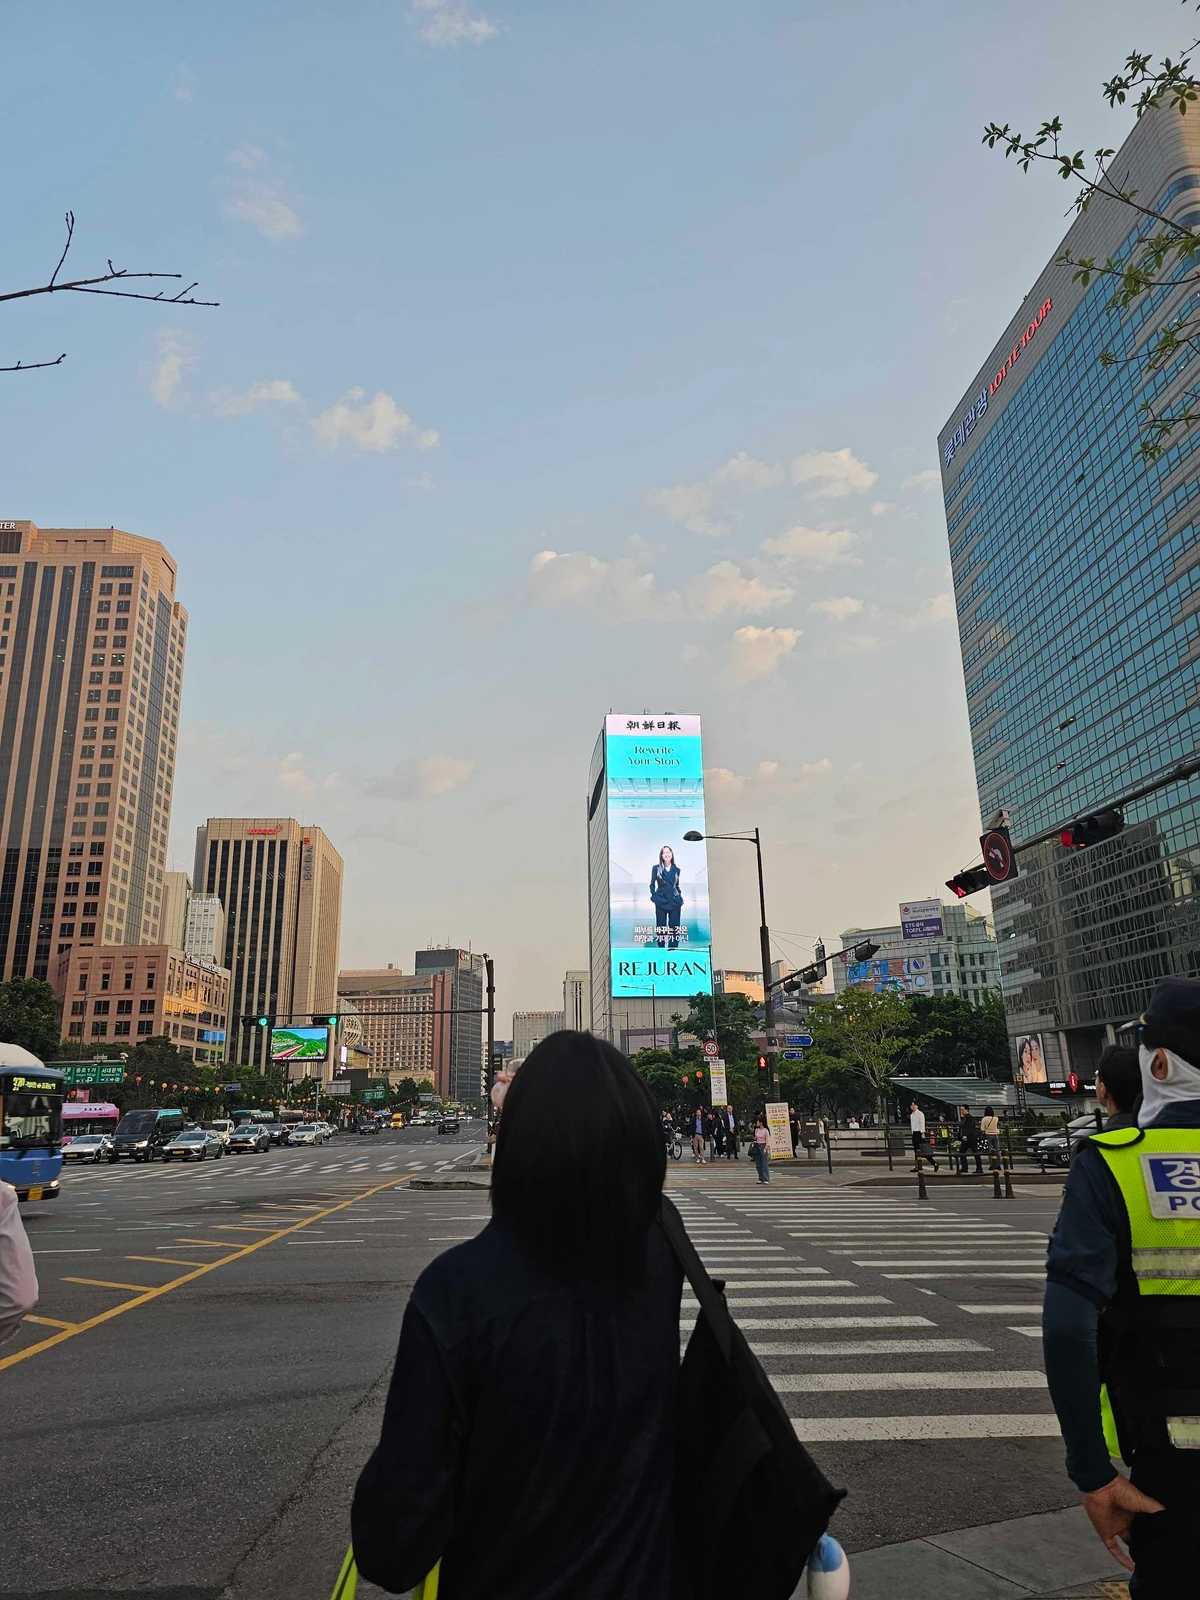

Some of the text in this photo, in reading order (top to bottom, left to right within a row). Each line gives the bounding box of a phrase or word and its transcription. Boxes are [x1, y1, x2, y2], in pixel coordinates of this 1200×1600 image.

[989, 297, 1052, 395] LOTTE TOUR
[944, 388, 988, 467] 롯데관광
[626, 720, 681, 731] 朝鮮日報
[634, 745, 674, 754] Rewrite
[628, 757, 681, 767] Your Story
[675, 926, 688, 934] 것은
[619, 962, 707, 975] REJURAN
